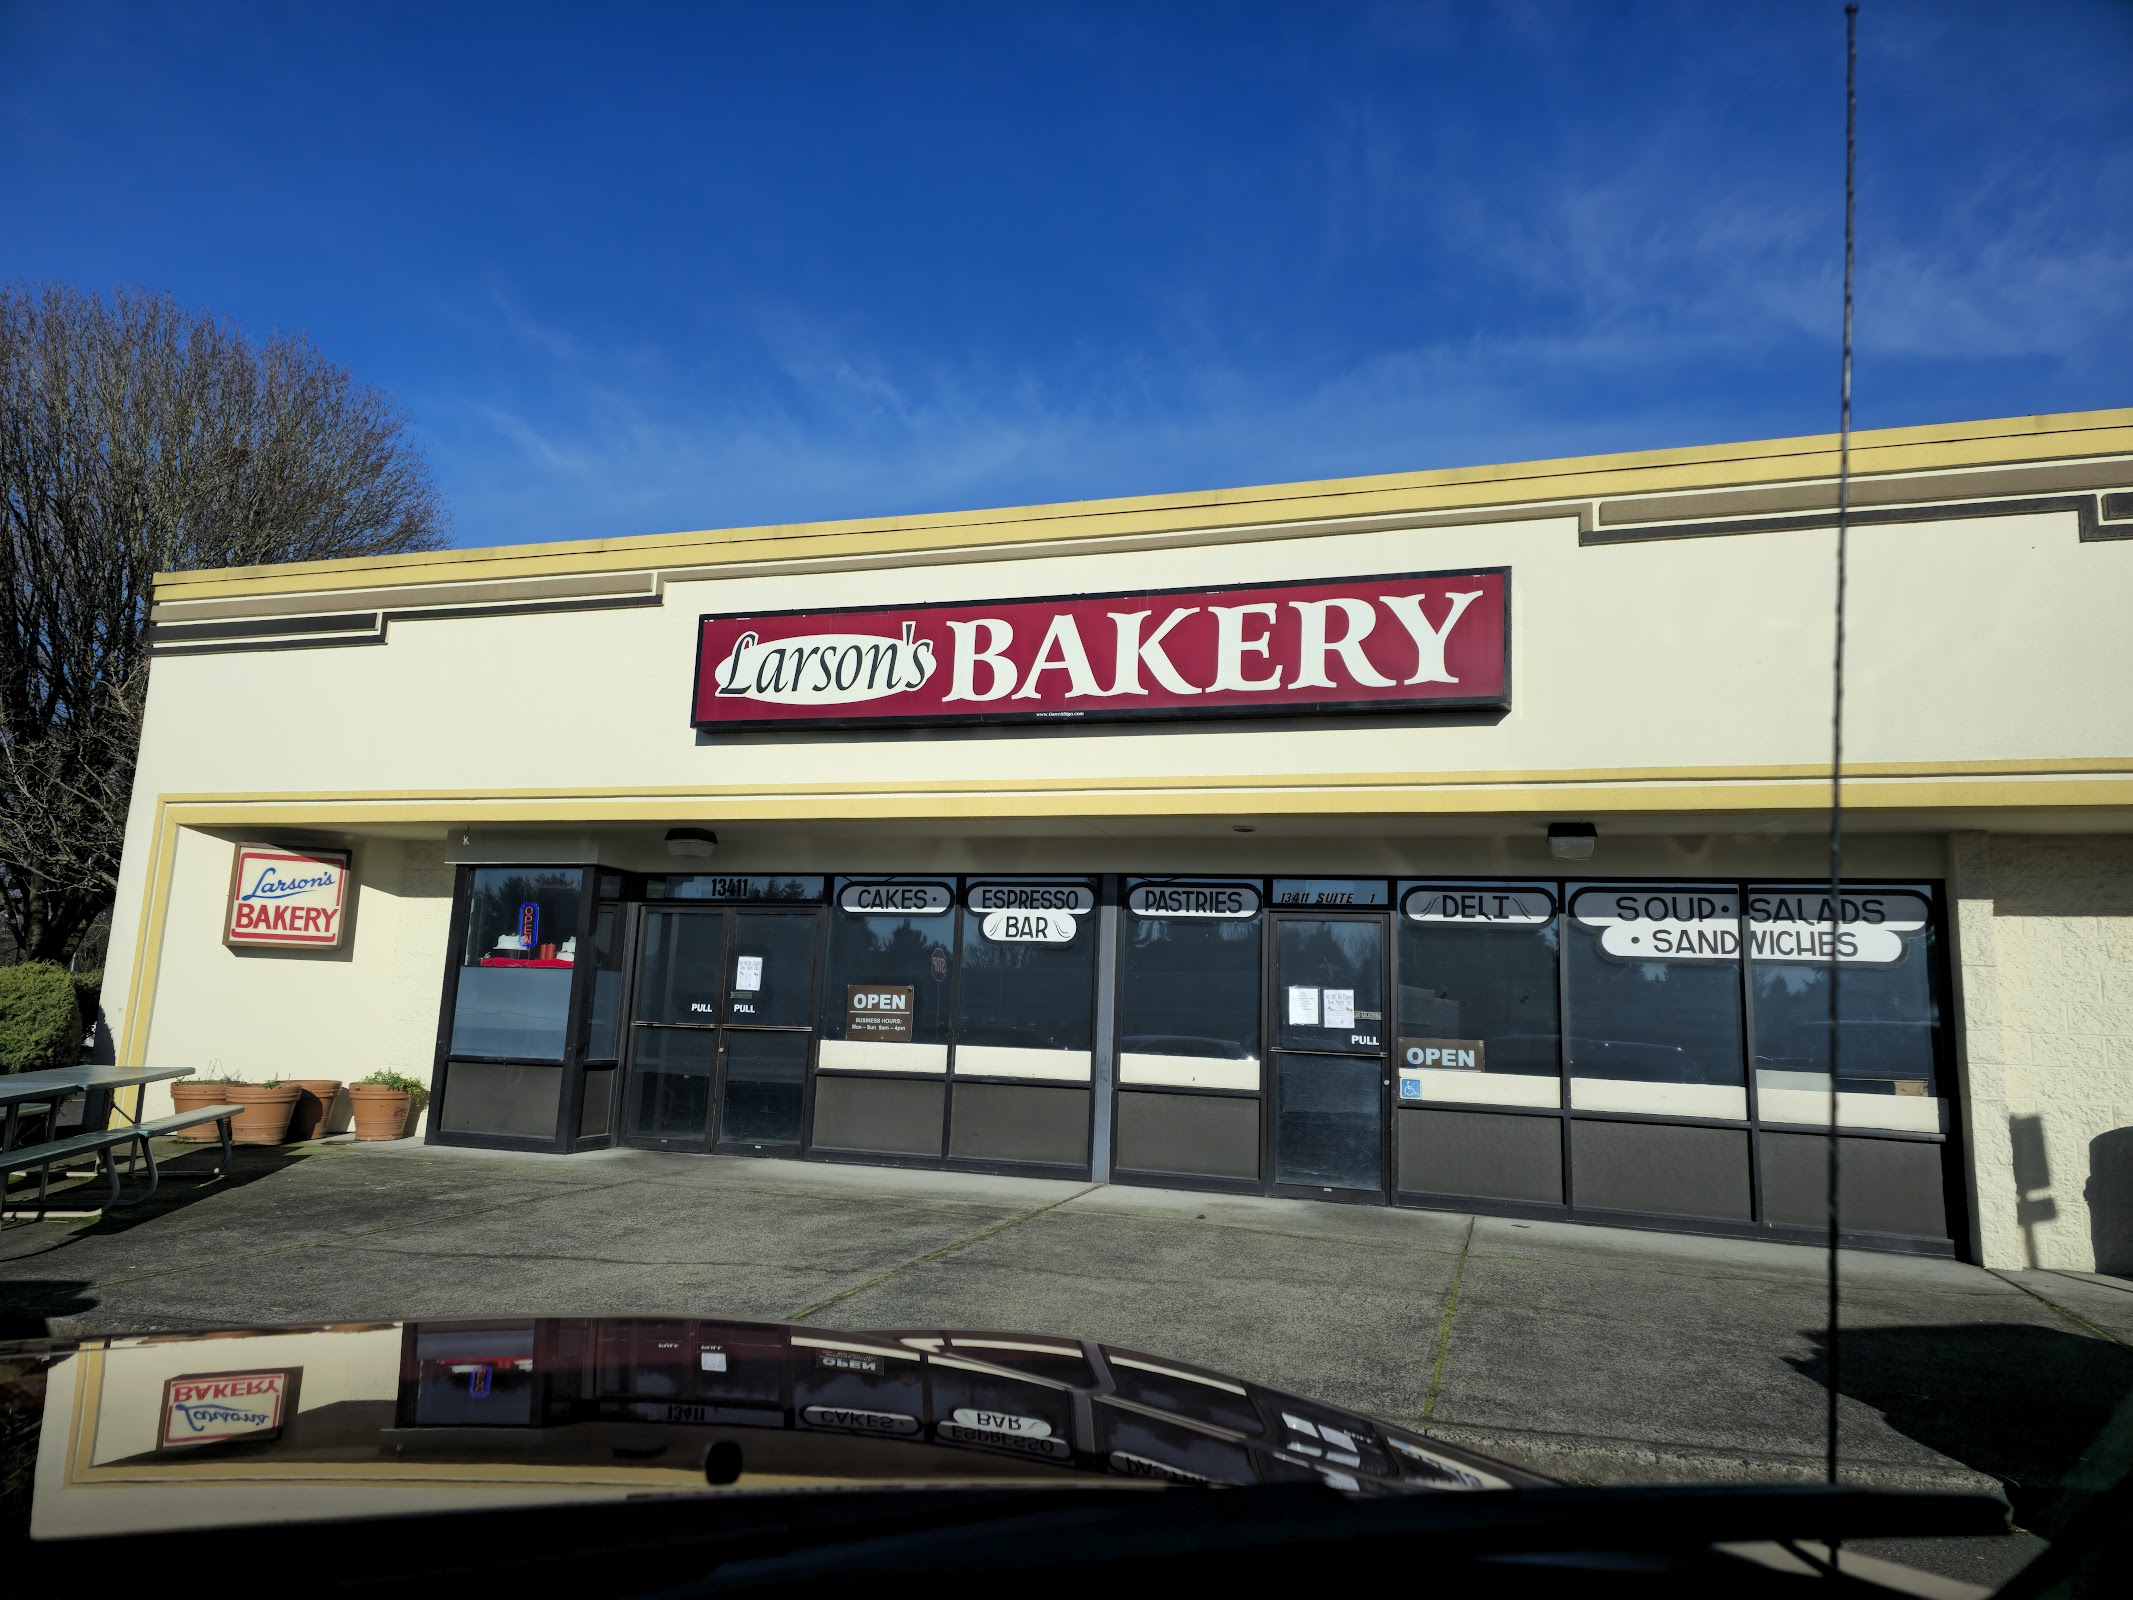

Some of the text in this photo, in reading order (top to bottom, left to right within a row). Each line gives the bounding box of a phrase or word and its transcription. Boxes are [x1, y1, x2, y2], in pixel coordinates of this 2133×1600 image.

[717, 590, 1483, 702] Larson's BAKERY
[241, 867, 336, 902] Larson's
[711, 878, 748, 897] 13411
[857, 888, 928, 911] CAKES
[982, 888, 1079, 911] ESPRESSO
[1145, 890, 1243, 914] PASTRIES
[1280, 892, 1376, 904] 13411 SUITE 1
[1442, 894, 1510, 921] DELI
[235, 902, 339, 933] BAKERY
[1615, 896, 1886, 926] SOUP SALADS
[523, 905, 534, 945] OPEN
[1005, 916, 1049, 938] BAR
[1652, 929, 1859, 957] SANDWICHES
[691, 1003, 713, 1013] PULL
[733, 1004, 756, 1013] PULL
[853, 993, 906, 1010] OPEN
[1351, 1035, 1380, 1046] PULL
[1406, 1047, 1476, 1068] OPEN
